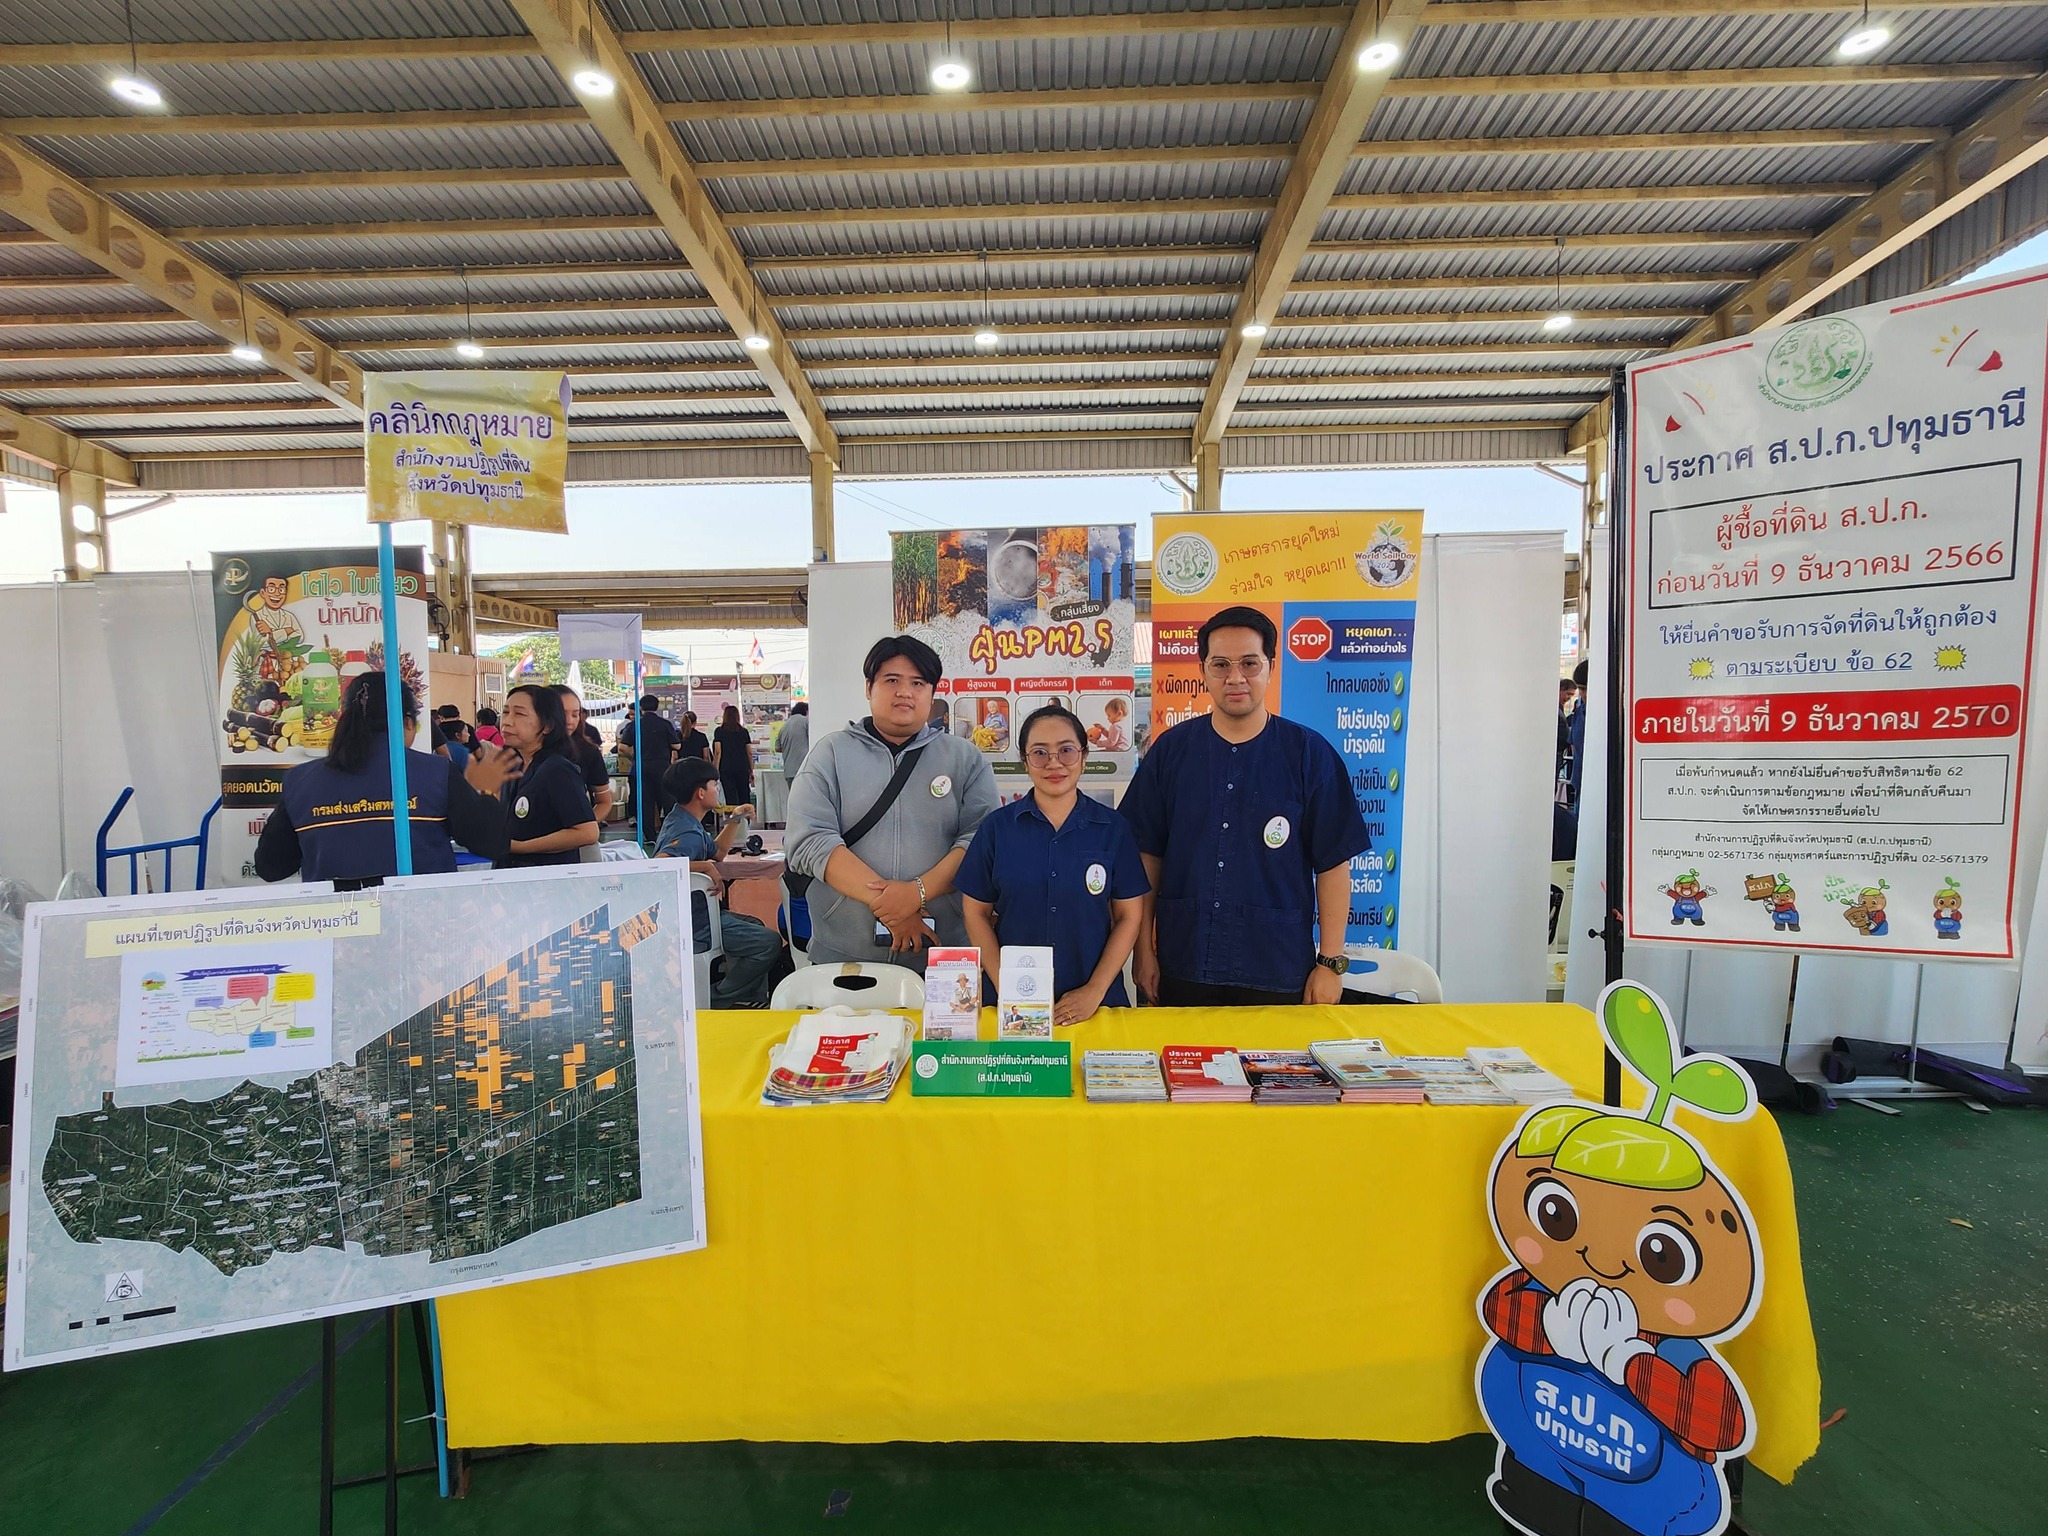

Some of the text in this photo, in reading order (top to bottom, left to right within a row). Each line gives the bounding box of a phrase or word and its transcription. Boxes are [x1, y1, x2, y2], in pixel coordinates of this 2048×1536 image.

[368, 401, 553, 447] คลินิกกฎหมาย
[1644, 386, 2027, 485] ประกาศ ส.ป.ก.ปทุมธานี
[395, 448, 531, 478] สำนักงานปฏิรูปที่ดิน
[409, 474, 525, 503] จังหวัดปทุมธานี
[1841, 500, 1928, 528] ส.ป.ก.
[1223, 520, 1341, 564] เกษตรกรยุคใหม่
[1355, 552, 1417, 561] World Soil Day
[1657, 540, 2005, 595] ก่อนวันที่ 9 ธันวาคม 2566
[301, 569, 342, 597] โตไว
[1230, 572, 1273, 596] ร่วมใจ
[1059, 602, 1101, 621] กลุ่มเสี่ยง
[1659, 604, 1997, 645] ให้ยื่นคำขอรับการจัดที่ดินให้ถูกต้อง
[1158, 642, 1199, 656] ไม่ดีอย่
[1292, 633, 1327, 646] STOP
[1341, 641, 1407, 655] แล้วทำอย่างไร
[1726, 649, 1912, 678] ตามระเบียบ ข้อ 62
[967, 679, 997, 690] ผู้สูงอายุ
[1020, 678, 1068, 689] หญิงตั้งครรภ์
[1098, 677, 1113, 687] เด็ก
[1336, 707, 1390, 735] ใช้ปรับปรุง
[1641, 700, 2010, 735] ภายในวันที่ 9 ธันวาคม 2570
[1343, 732, 1386, 758] บำรุงดิน
[1675, 765, 1964, 780] เมื่อพ้นกำหนดแล้ว หากยังไม่ยื่นคำขอรับสิทธิตามข้อ 62
[1667, 784, 1971, 801] ส.ป.ก. จะดำเนินการตามข้อกฎหมาย เพื่อนำที่ดินกลับคืนมา
[1742, 803, 1880, 817] จัดให้เกษตรกรรายอื่นต่อไป
[1695, 833, 1932, 849] สำนักงานการปฏิรูปที่ดินจังหวัดปทุมธานี (ส.ป.ก.ปทุมธานี)
[1651, 847, 1705, 859] กลุ่มกฎหมาย
[1707, 850, 1764, 861] 02-5671736
[1921, 853, 1988, 864] 02-5671379
[115, 910, 359, 945] แผนที่เขตปฏิรูปที่ดินจังหวัดปทุมธานี
[941, 1054, 1068, 1073] สำนักงานการปฏิรูปที่ดินจังหวัดปทุมธานี
[977, 1071, 1032, 1085] (ส.ป.ก.ปทุมธานี)
[1534, 1380, 1647, 1454] ส.ป.ก.
[1535, 1411, 1632, 1475] ปทุมธานี
